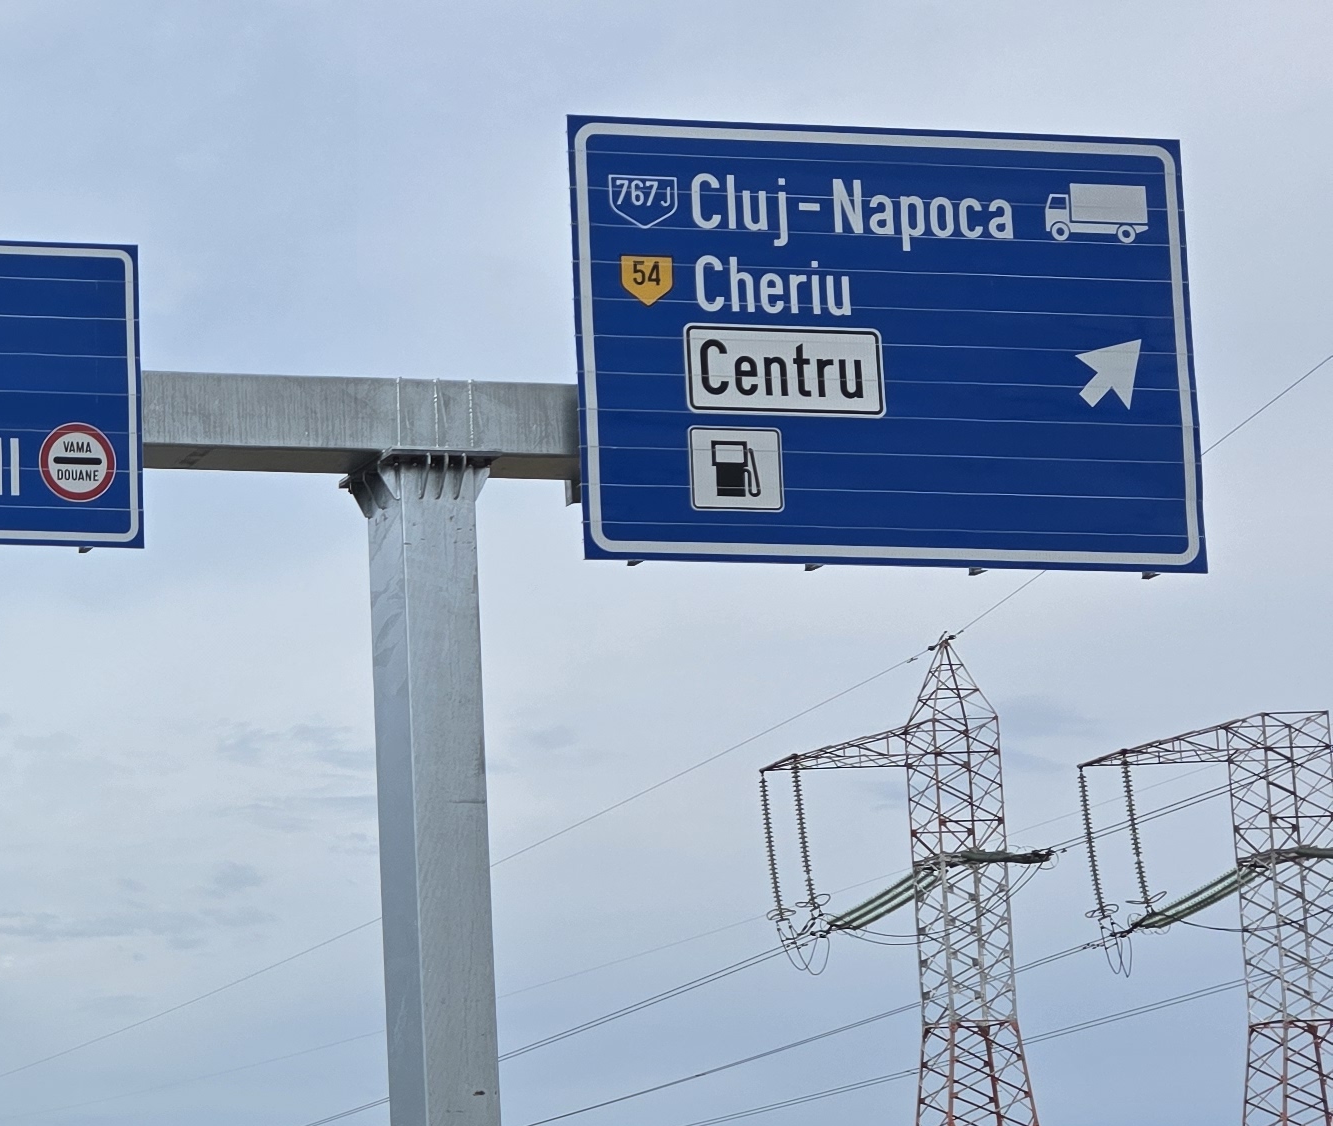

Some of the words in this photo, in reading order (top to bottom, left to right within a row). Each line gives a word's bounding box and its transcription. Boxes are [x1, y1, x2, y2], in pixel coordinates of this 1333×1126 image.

[616, 180, 671, 206] 767J
[690, 172, 1014, 251] Cluj-Napoca
[632, 261, 661, 286] 54
[694, 254, 852, 316] Cheriu
[698, 339, 864, 399] Centru
[63, 440, 92, 453] VAMA
[57, 468, 99, 481] DOUANE
